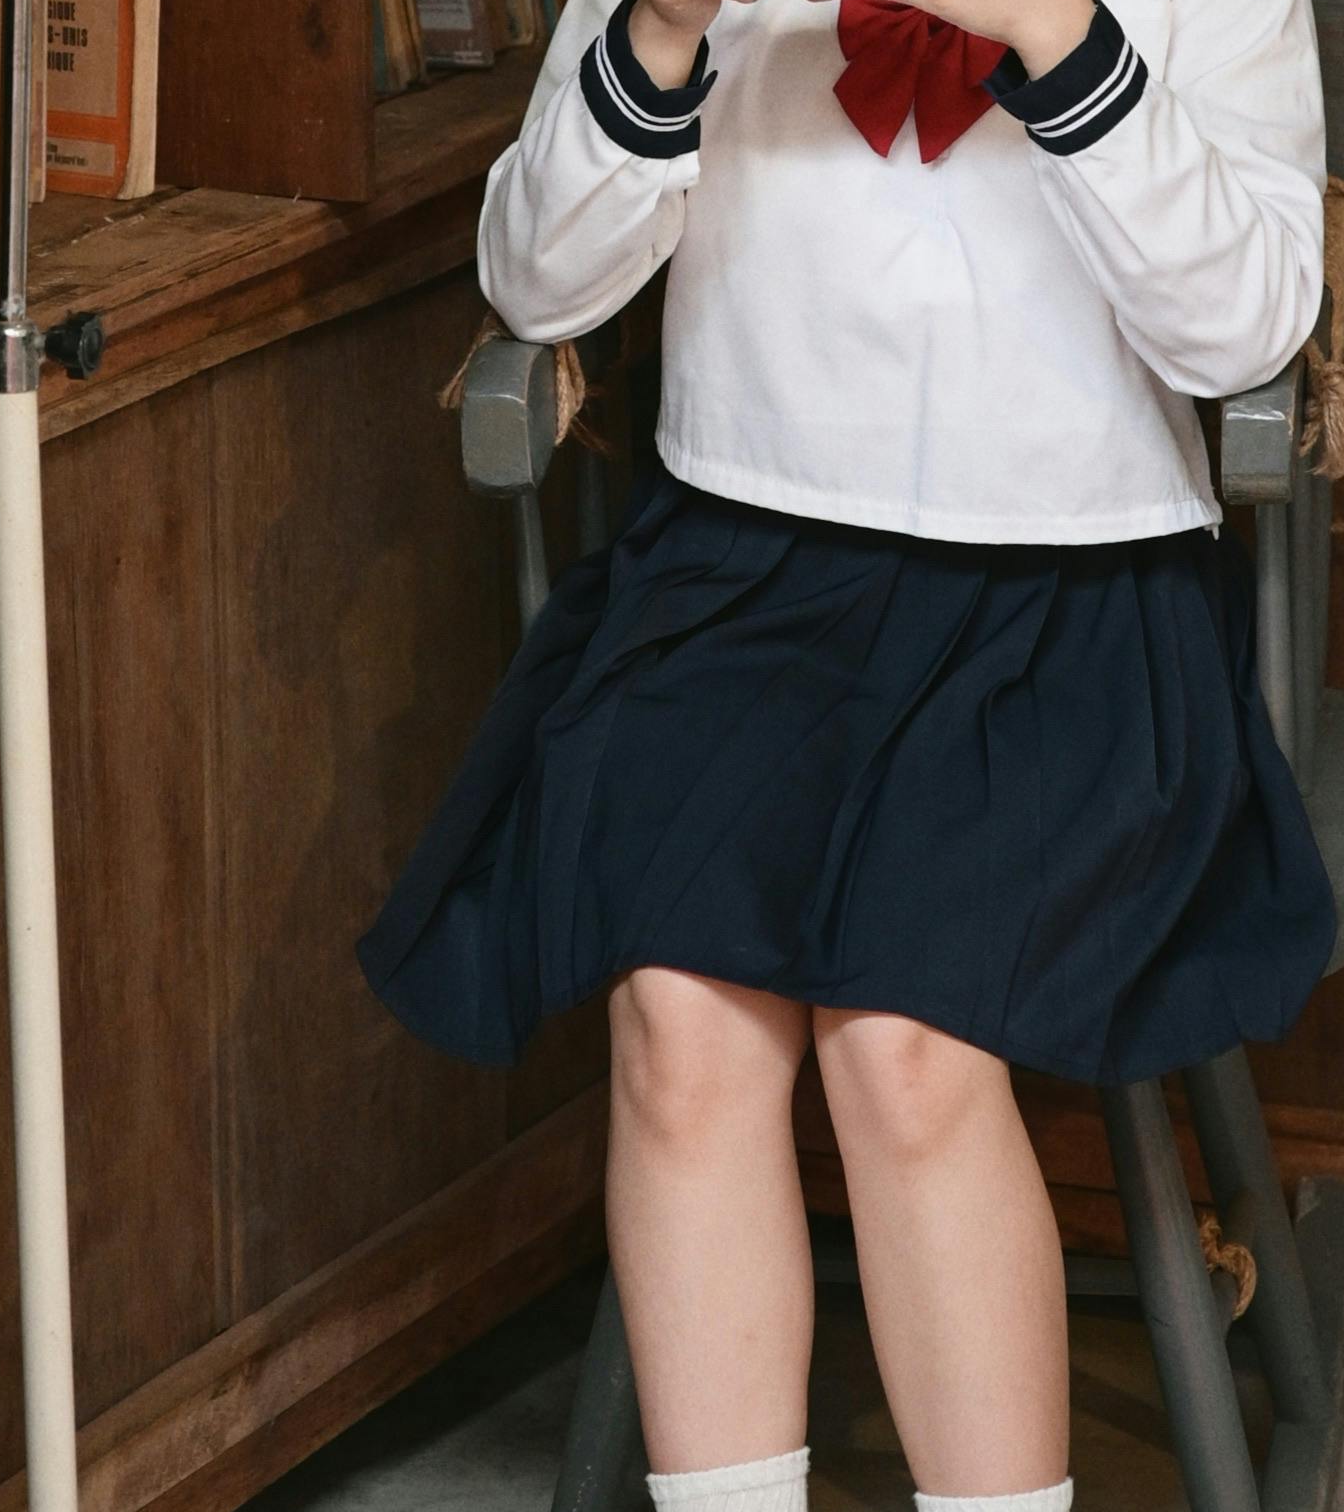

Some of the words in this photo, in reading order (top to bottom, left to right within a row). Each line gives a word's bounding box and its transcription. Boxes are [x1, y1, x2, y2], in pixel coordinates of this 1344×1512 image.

[48, 0, 76, 22] GIQUE
[47, 24, 88, 48] S-UNIS
[47, 50, 75, 73] IQUE
